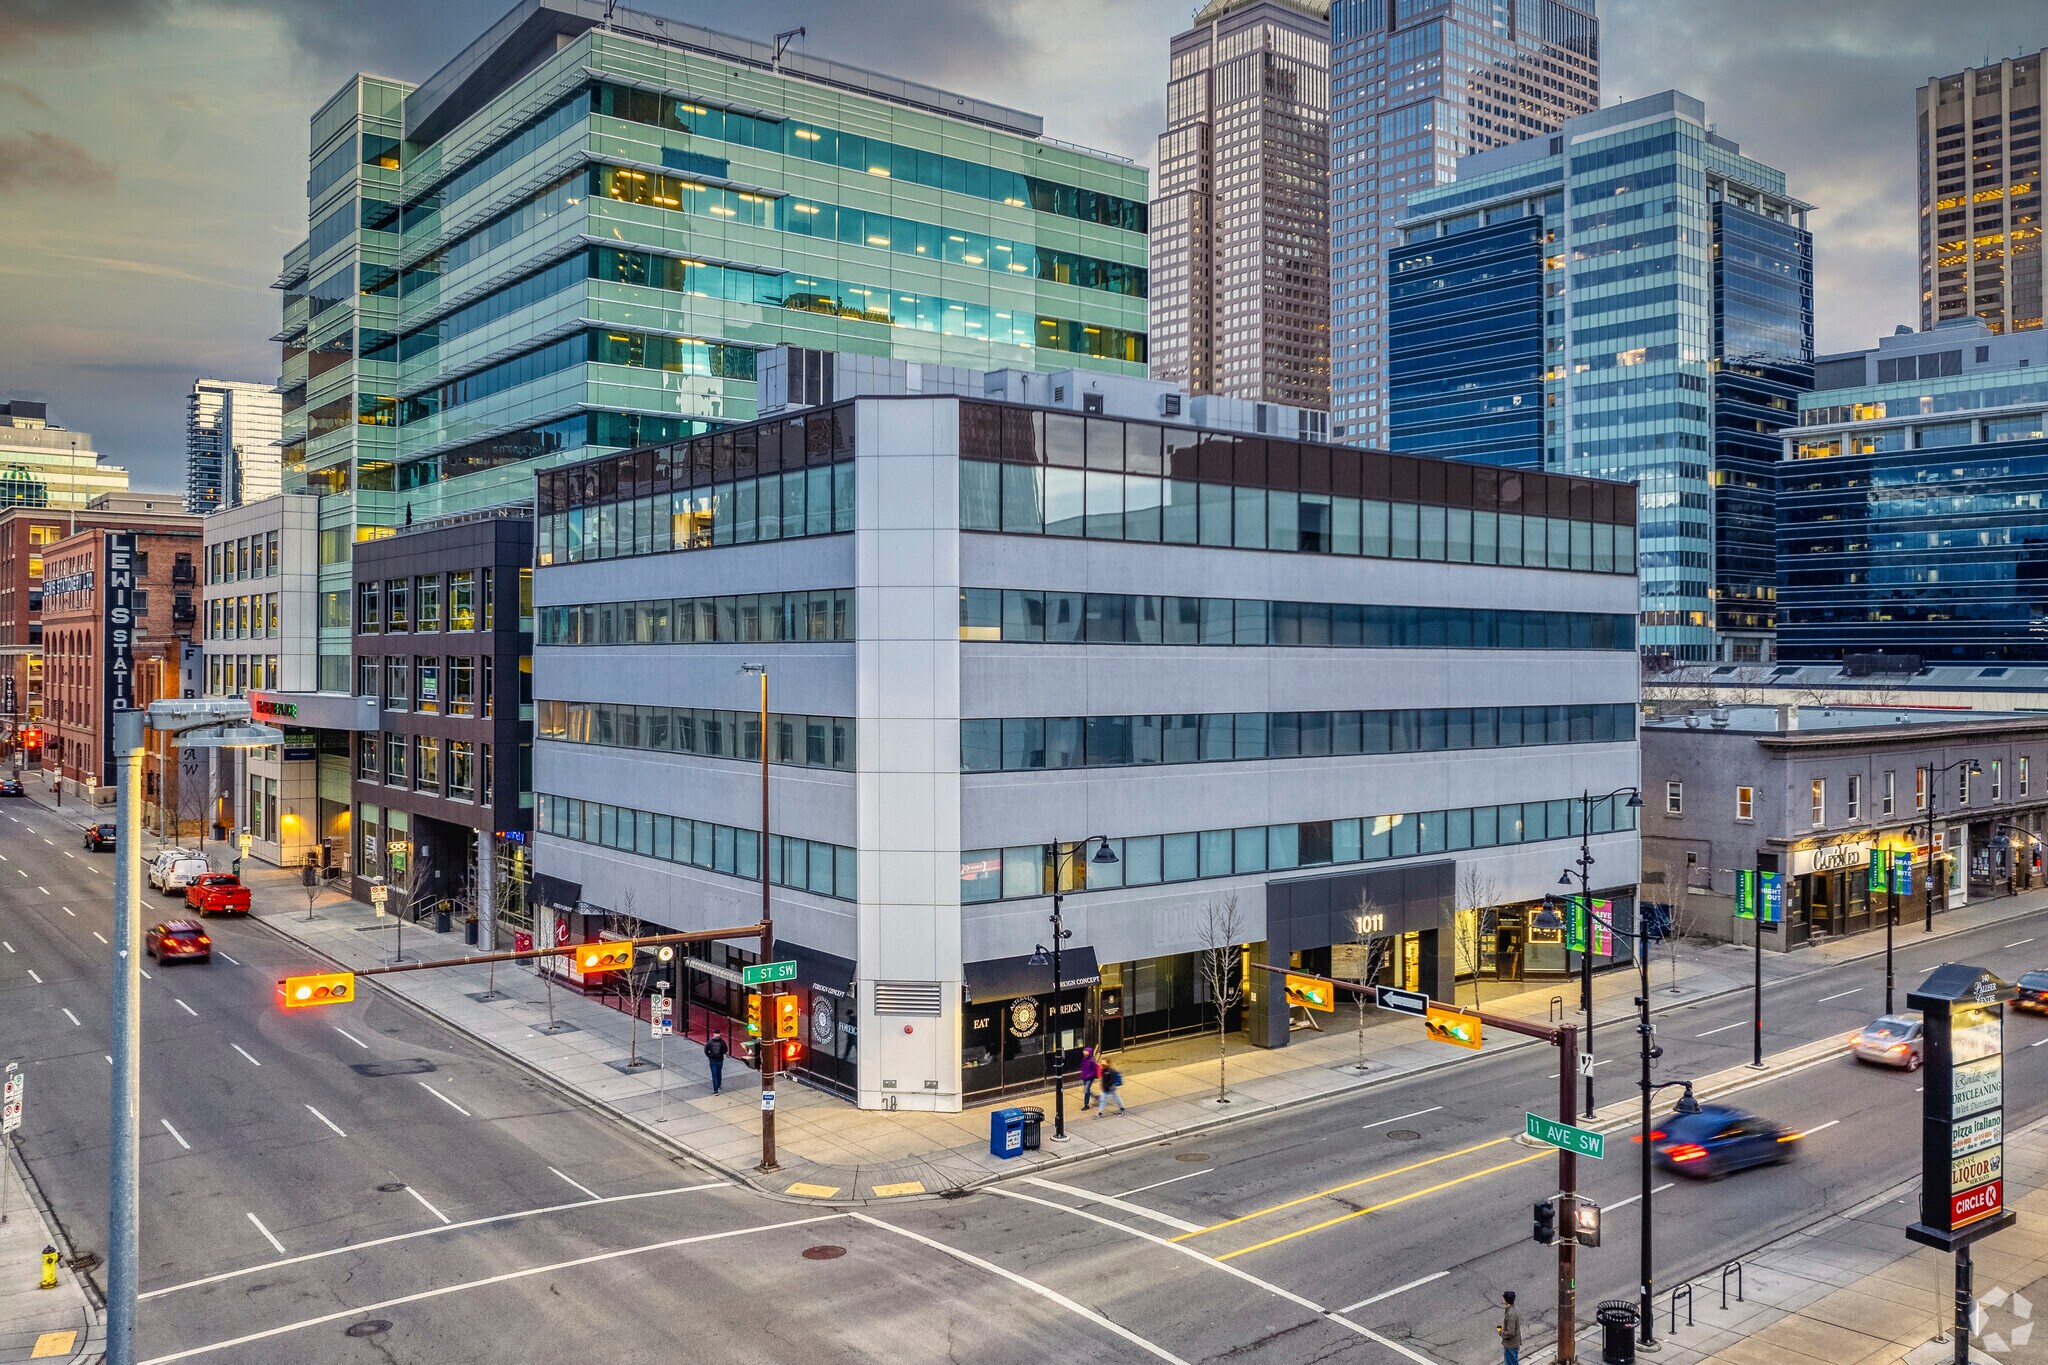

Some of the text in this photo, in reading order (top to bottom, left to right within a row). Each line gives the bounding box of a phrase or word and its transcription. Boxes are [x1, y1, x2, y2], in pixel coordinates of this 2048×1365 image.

[111, 535, 130, 751] LEWIS STATIO
[1355, 914, 1384, 934] 1011
[1595, 911, 1612, 919] LIVE
[746, 964, 794, 981] 1 ST SW
[1076, 976, 1100, 985] CONCEPT
[812, 982, 845, 997] FOREIGN CONCEPT
[973, 1018, 990, 1030] EAT
[1952, 1081, 2001, 1104] DRYCLEANING
[1529, 1119, 1600, 1152] 11 AVE SW
[1952, 1125, 1973, 1142] pizza
[1974, 1116, 2001, 1132] italiano
[1952, 1160, 1990, 1184] LIQUOR
[1956, 1186, 1997, 1214] CIRCLE K
